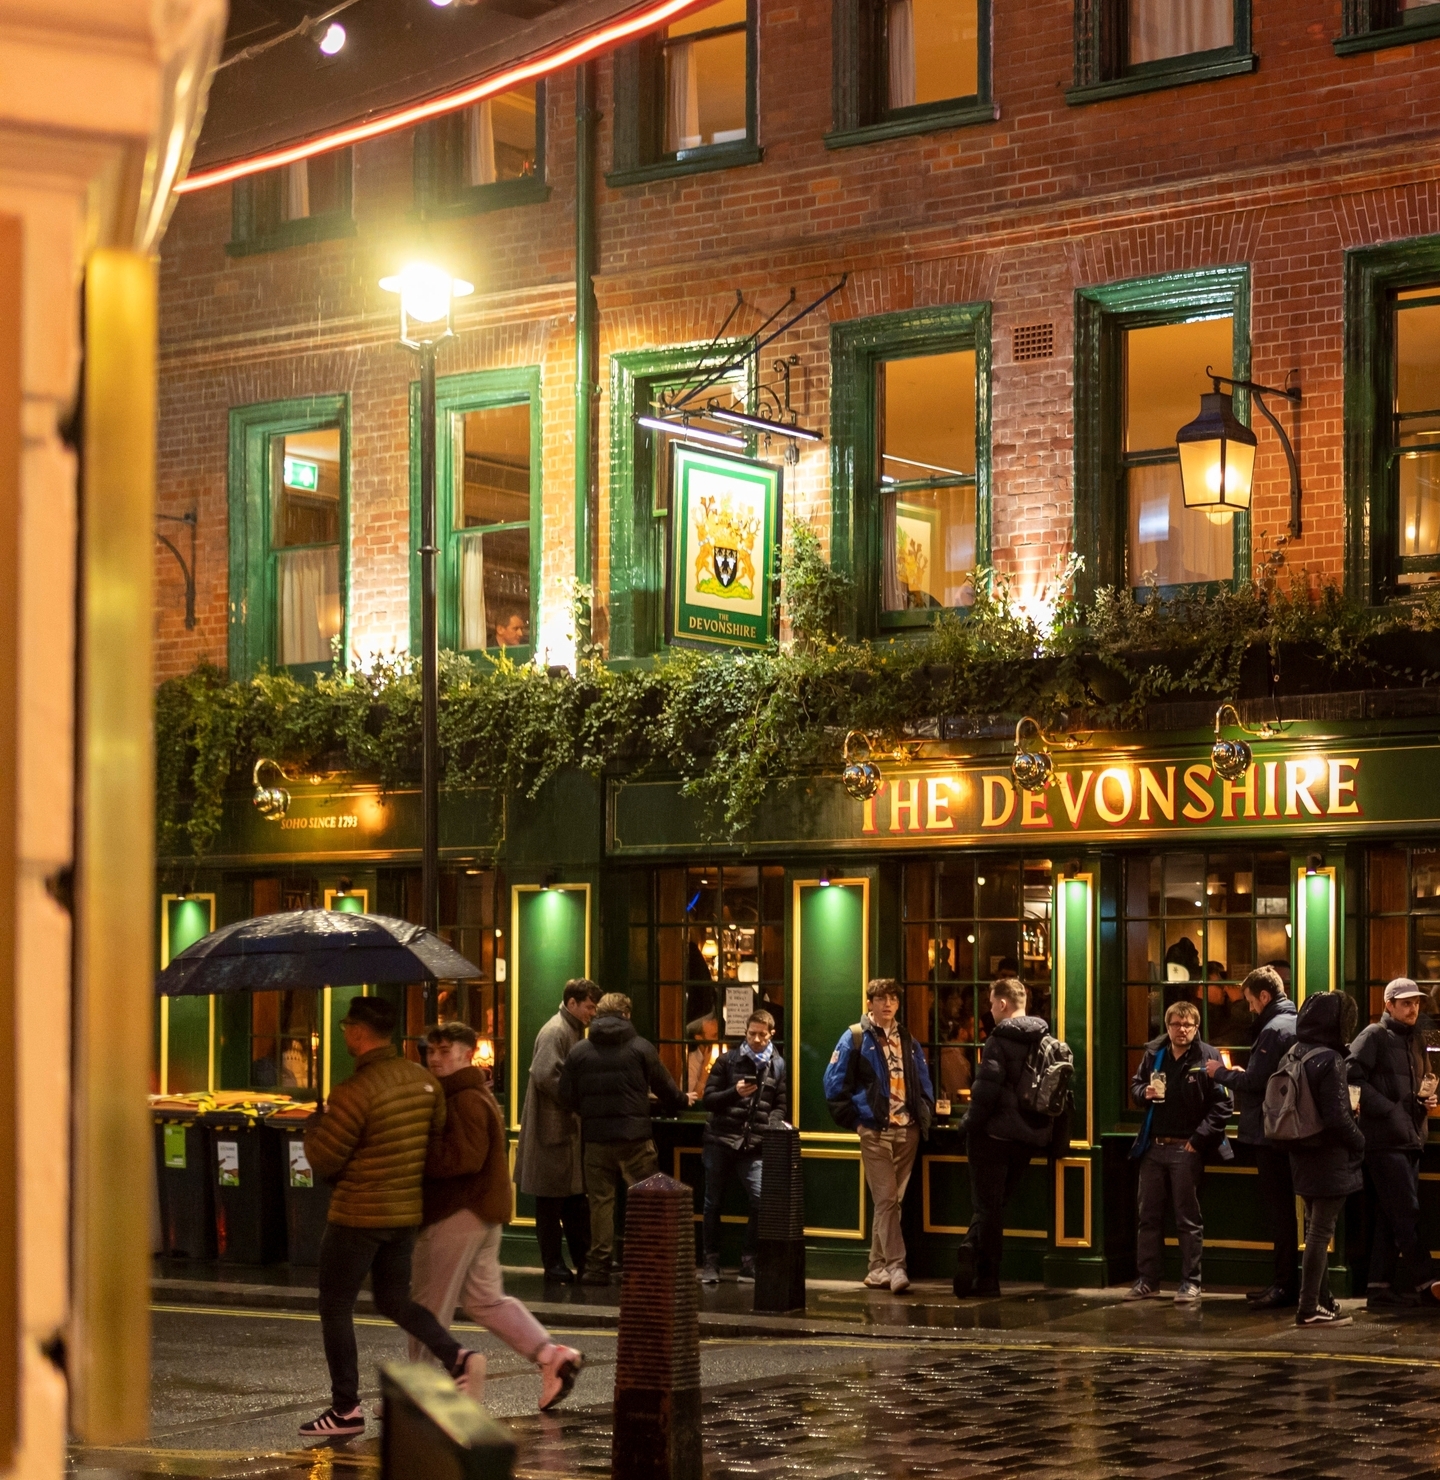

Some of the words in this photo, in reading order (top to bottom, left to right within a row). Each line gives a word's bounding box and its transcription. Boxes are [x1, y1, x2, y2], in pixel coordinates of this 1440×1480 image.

[718, 613, 729, 621] THE
[689, 616, 756, 638] DEVONSHIRE
[861, 776, 956, 832] THE
[981, 758, 1360, 829] DEVONSHIRE
[281, 818, 308, 829] SOHO
[308, 816, 336, 828] SINCE
[338, 816, 358, 828] 1793
